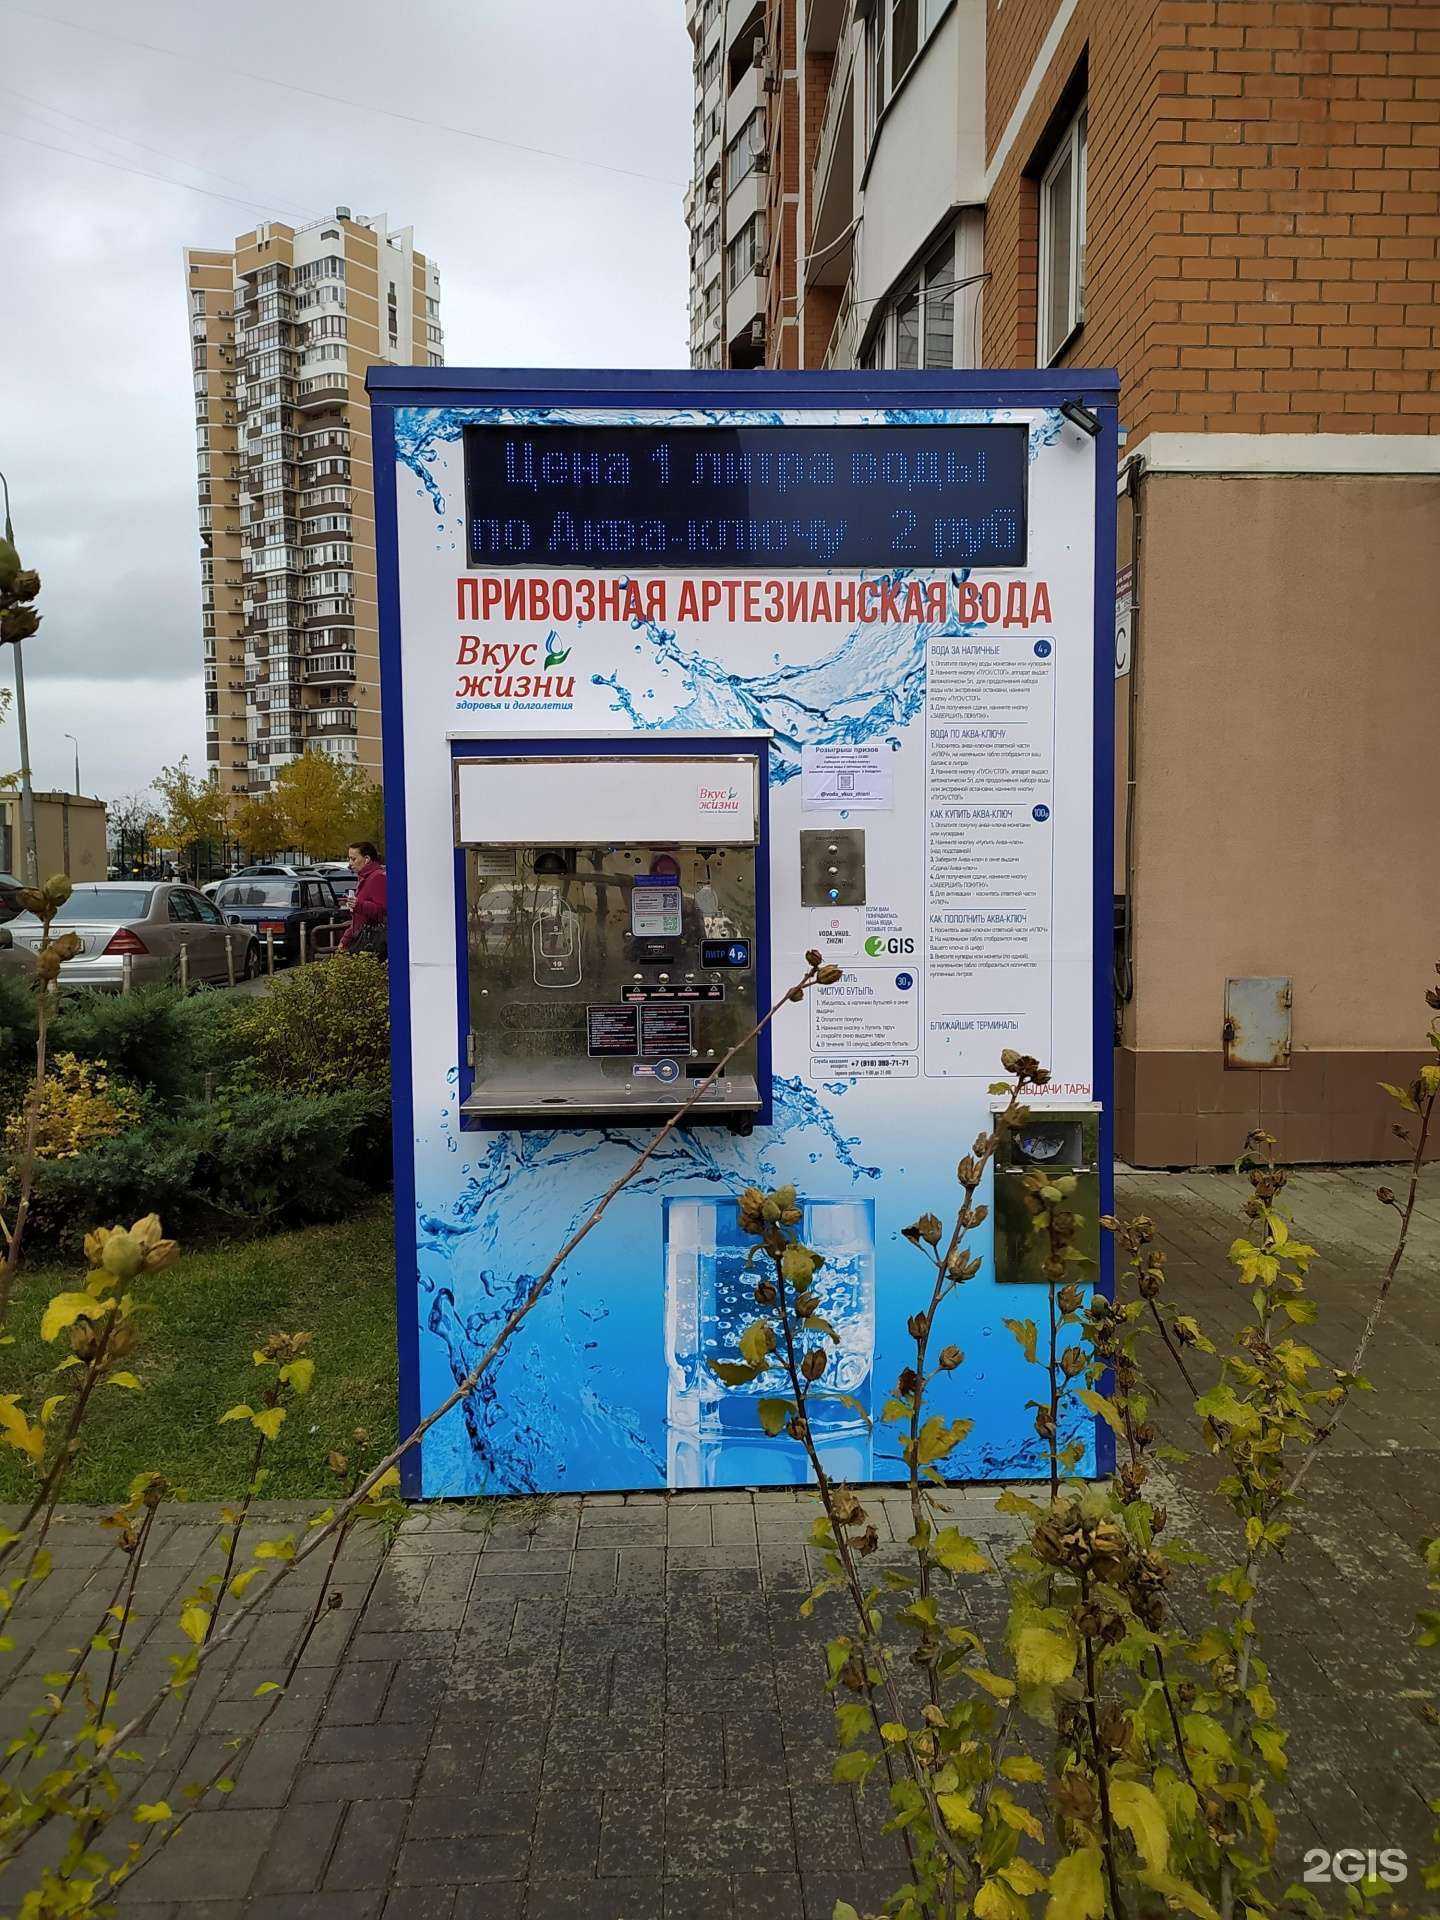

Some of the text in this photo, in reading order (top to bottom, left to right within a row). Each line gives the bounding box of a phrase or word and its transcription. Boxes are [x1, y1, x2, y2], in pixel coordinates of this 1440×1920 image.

[506, 441, 985, 492] Цена 1 литра воды
[474, 520, 530, 550] по
[550, 512, 847, 558] Аква-ключу
[892, 510, 916, 548] 2
[935, 510, 1015, 557] руб
[457, 578, 1052, 628] ПРИВОЗНАЯ АРТЕЗИАНСКАЯ ВОДА
[456, 636, 537, 673] Вкус
[931, 645, 1000, 656] ВОДА ЗА НАЛИЧНЫЕ
[456, 676, 576, 697] жизни
[456, 701, 501, 711] здоровья
[513, 701, 572, 711] долголетия
[930, 730, 1006, 740] ВОДА ПО АКВА-КЛЮЧУ
[700, 788, 726, 801] Вкус
[930, 810, 1013, 819] КАК КУПИТЬ АКВА-КЛЮЧ
[930, 914, 1026, 923] КАК ПОПОЛНИТЬ АКВА-КЛЮЧ
[728, 948, 735, 958] 4
[817, 987, 873, 995] ЧИСТУЮ БУТЫЛЬ
[930, 1020, 1018, 1030] БЛИЖАЙШИЕ ТЕРМИНАЛЫ
[1020, 1084, 1061, 1096] ВЫДАЧИ
[1064, 1084, 1090, 1094] ТАРЫ
